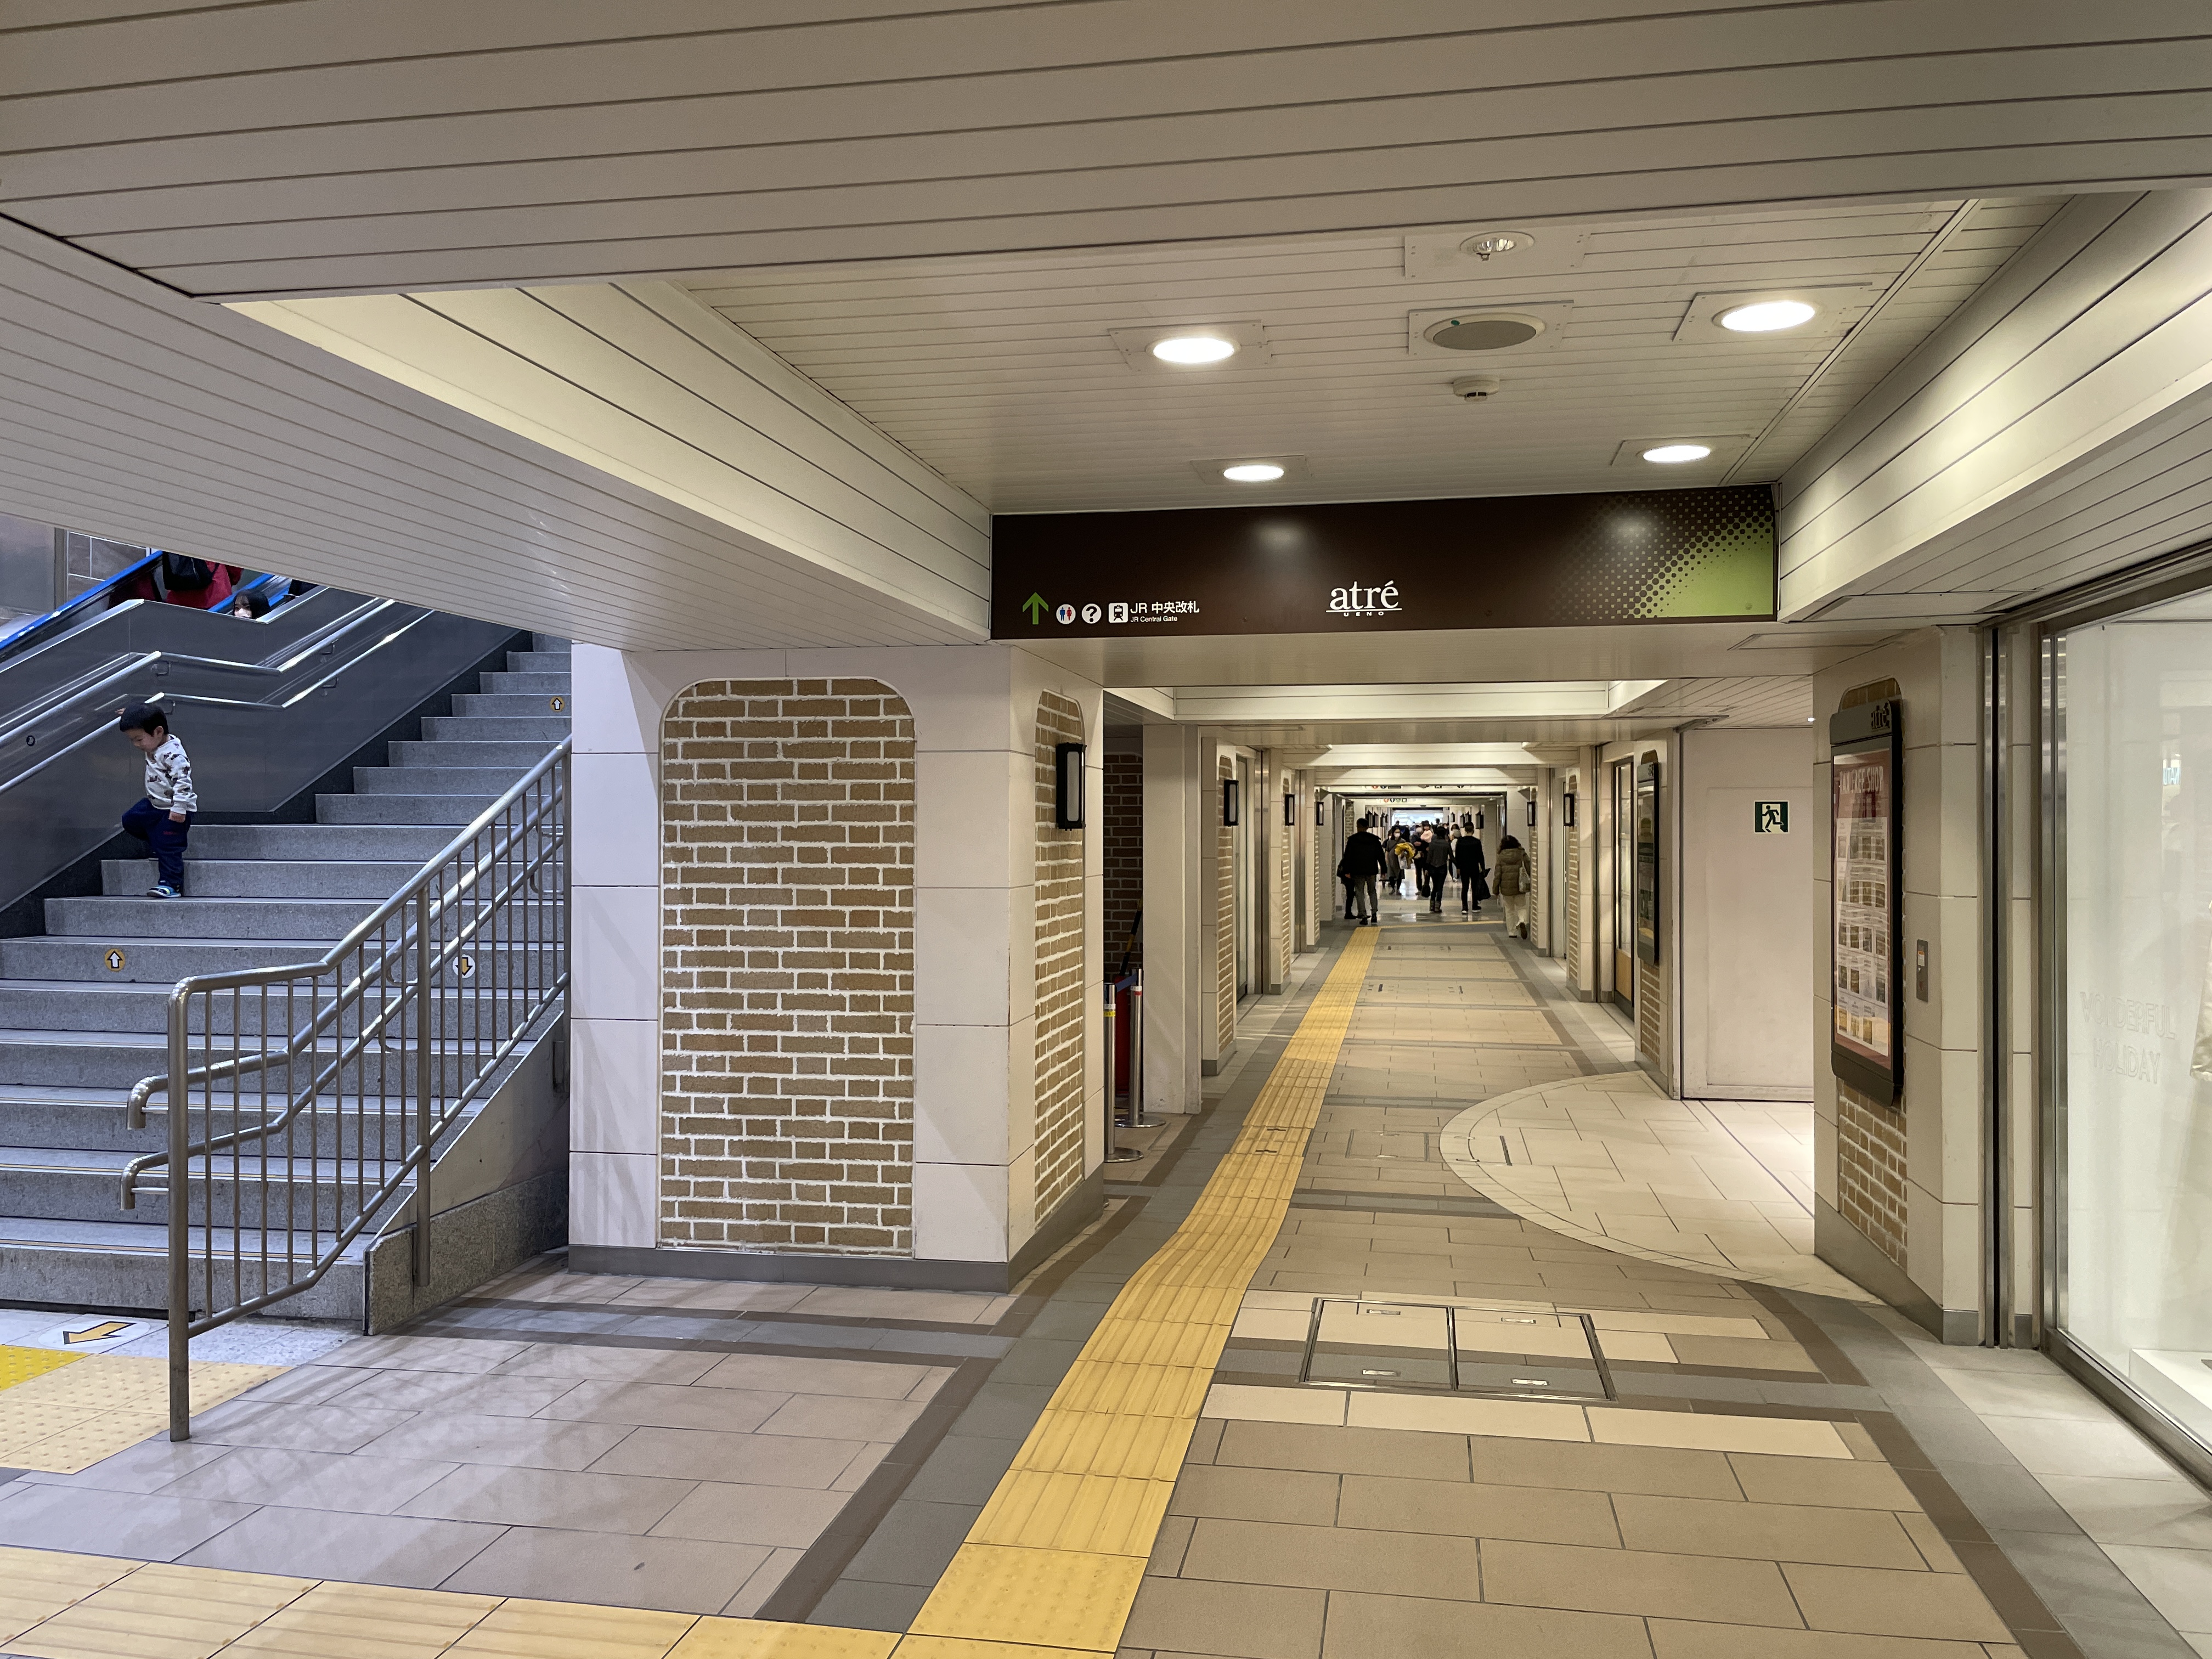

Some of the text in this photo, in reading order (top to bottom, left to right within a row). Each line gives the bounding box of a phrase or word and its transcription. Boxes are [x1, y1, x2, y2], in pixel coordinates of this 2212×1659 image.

[1130, 601, 1200, 614] JR 中央改札
[1330, 580, 1398, 610] atré
[1867, 766, 1883, 792] SHOP
[2094, 1037, 2160, 1084] HOLIDAY
